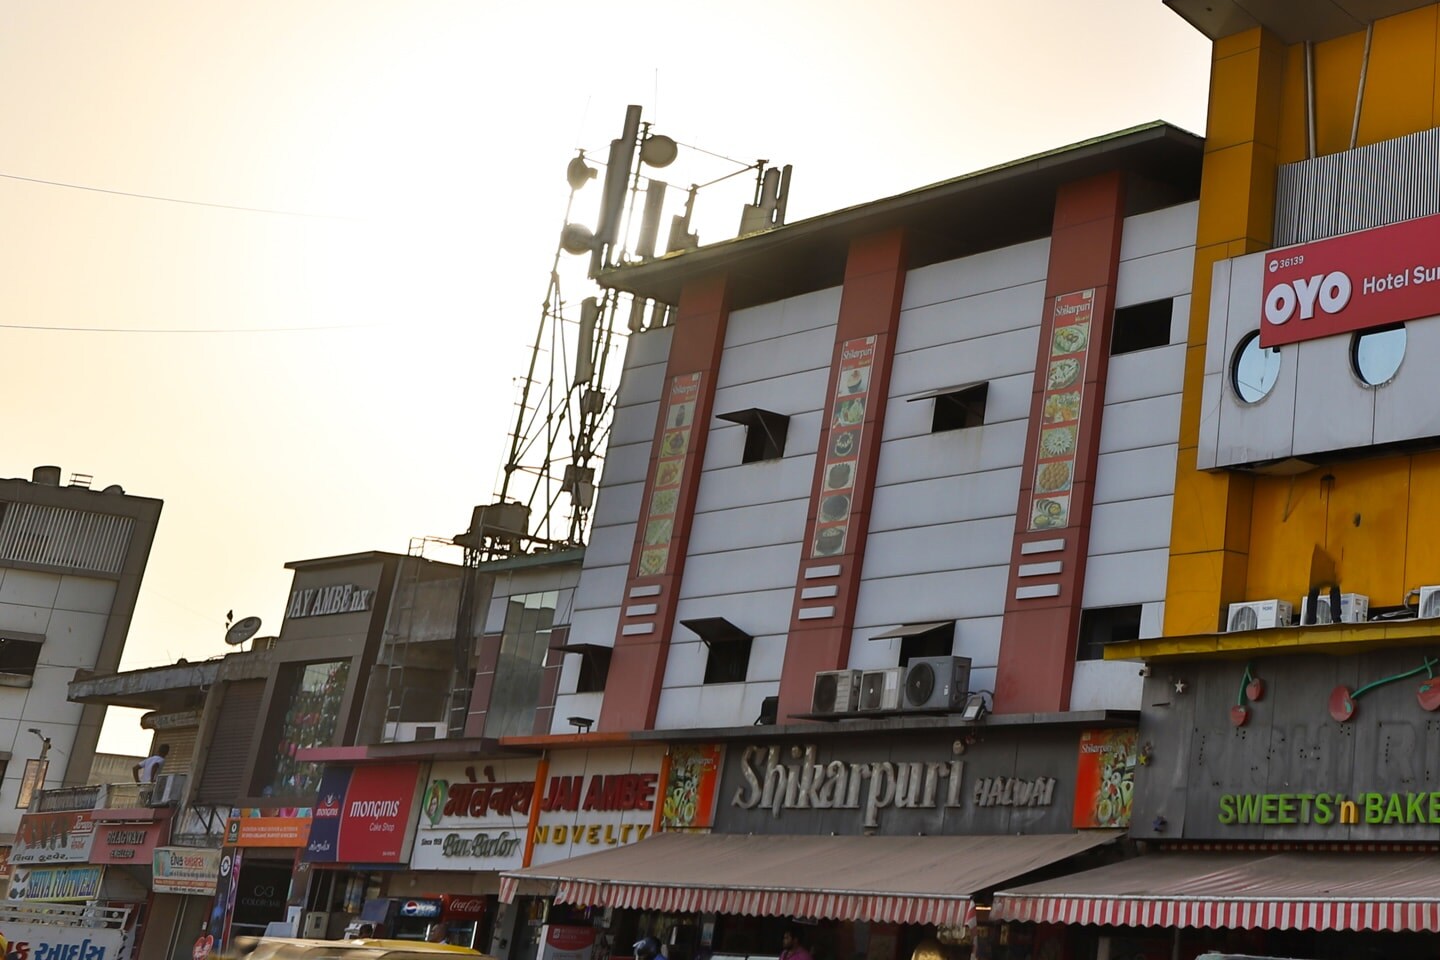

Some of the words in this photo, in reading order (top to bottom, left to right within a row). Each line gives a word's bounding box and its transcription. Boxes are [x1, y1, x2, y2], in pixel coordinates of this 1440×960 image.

[1279, 255, 1304, 269] 36139
[1363, 269, 1409, 295] Hotel
[1265, 271, 1352, 325] OYO
[287, 589, 313, 618] JAY
[311, 584, 352, 616] AMBE
[541, 776, 585, 812] JAI
[582, 773, 658, 812] AMBE
[731, 740, 965, 828] Shikarpuri
[973, 775, 1056, 808] HALWAI
[369, 822, 382, 832] Cake
[382, 822, 395, 832] Shop
[533, 823, 651, 845] NOVELTY
